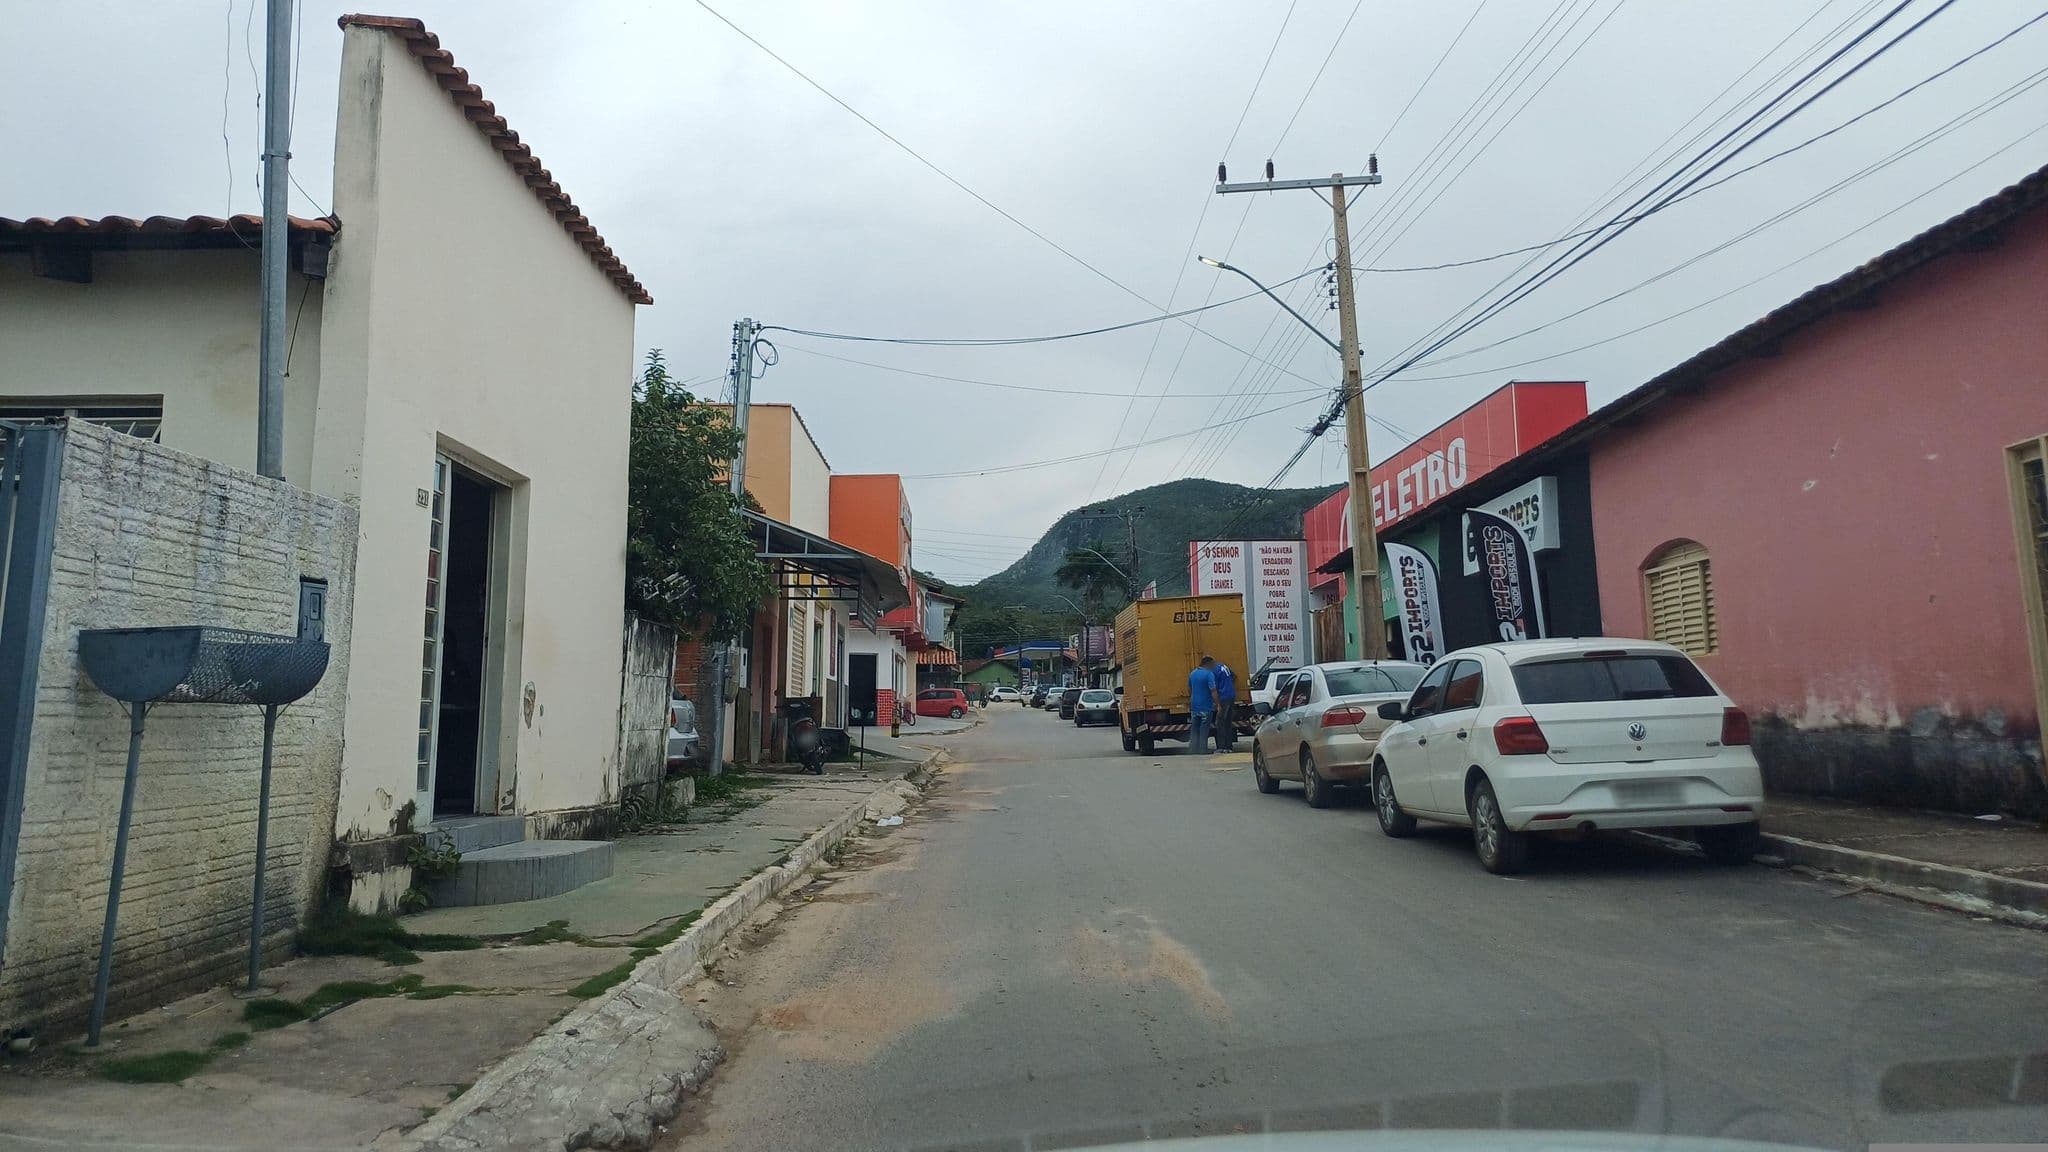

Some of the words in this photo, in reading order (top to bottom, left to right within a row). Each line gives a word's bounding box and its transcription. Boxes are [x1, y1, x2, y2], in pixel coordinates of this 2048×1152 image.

[1372, 437, 1467, 527] ELETRO
[1212, 546, 1240, 558] SENHOR
[1261, 557, 1292, 565] VERDADEIRO
[1213, 562, 1232, 573] DEUS
[1263, 568, 1290, 576] DESCANSO
[1483, 525, 1514, 620] IMPORTS
[1262, 579, 1275, 587] PARA
[1276, 579, 1281, 587] O
[1281, 579, 1292, 587] SEU
[1269, 590, 1286, 598] POBRE
[1399, 555, 1423, 632] IMPORTS
[1266, 600, 1290, 610] CORAÇÃO
[1278, 612, 1288, 620] QUE
[1274, 623, 1298, 631] APRENDA
